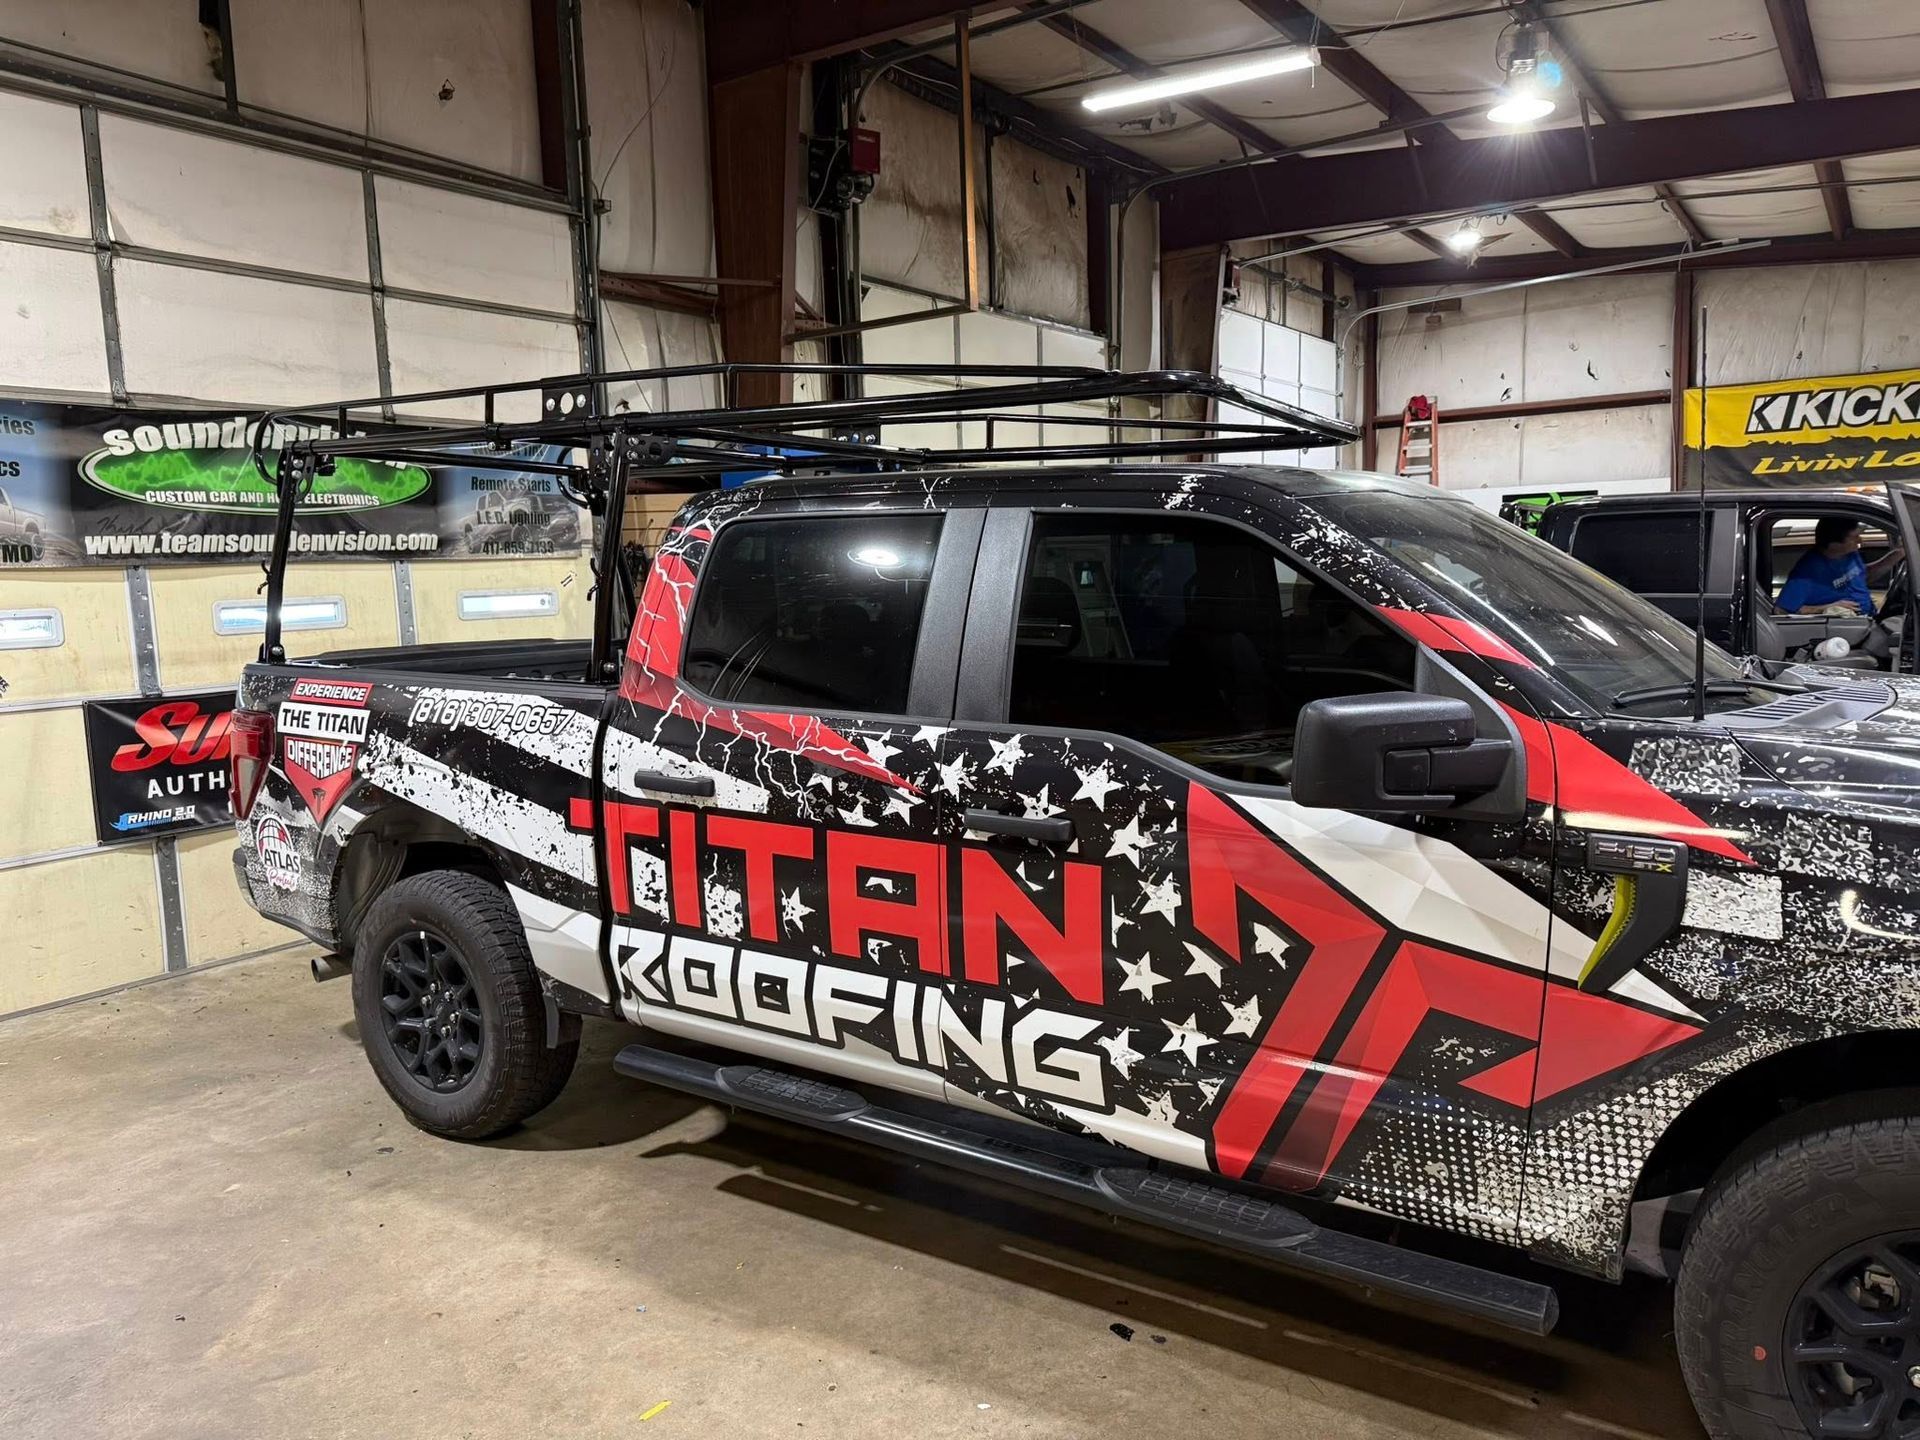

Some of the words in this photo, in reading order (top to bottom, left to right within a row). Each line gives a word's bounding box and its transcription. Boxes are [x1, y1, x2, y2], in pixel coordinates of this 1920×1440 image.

[1788, 383, 1920, 429] KICK
[470, 476, 516, 491] Remote
[519, 477, 551, 492] Starts
[145, 490, 207, 503] CUSTOM
[209, 491, 237, 503] CAR
[239, 491, 264, 503] AND
[304, 493, 380, 506] ELECTRONICS
[509, 511, 551, 526] Lighting
[2, 544, 33, 563] MO
[295, 683, 366, 702] EXPERIENCE
[282, 708, 310, 729] THE
[317, 711, 366, 735] TITAN
[287, 741, 353, 779] DIFFERENCE
[147, 770, 232, 798] AUTH
[127, 808, 172, 824] RHINO
[175, 804, 196, 816] 2.0
[264, 848, 299, 873] ATLAS
[1594, 841, 1676, 863] F-150
[570, 797, 1104, 1006] TITAN
[612, 924, 1106, 1107] ROOFING
